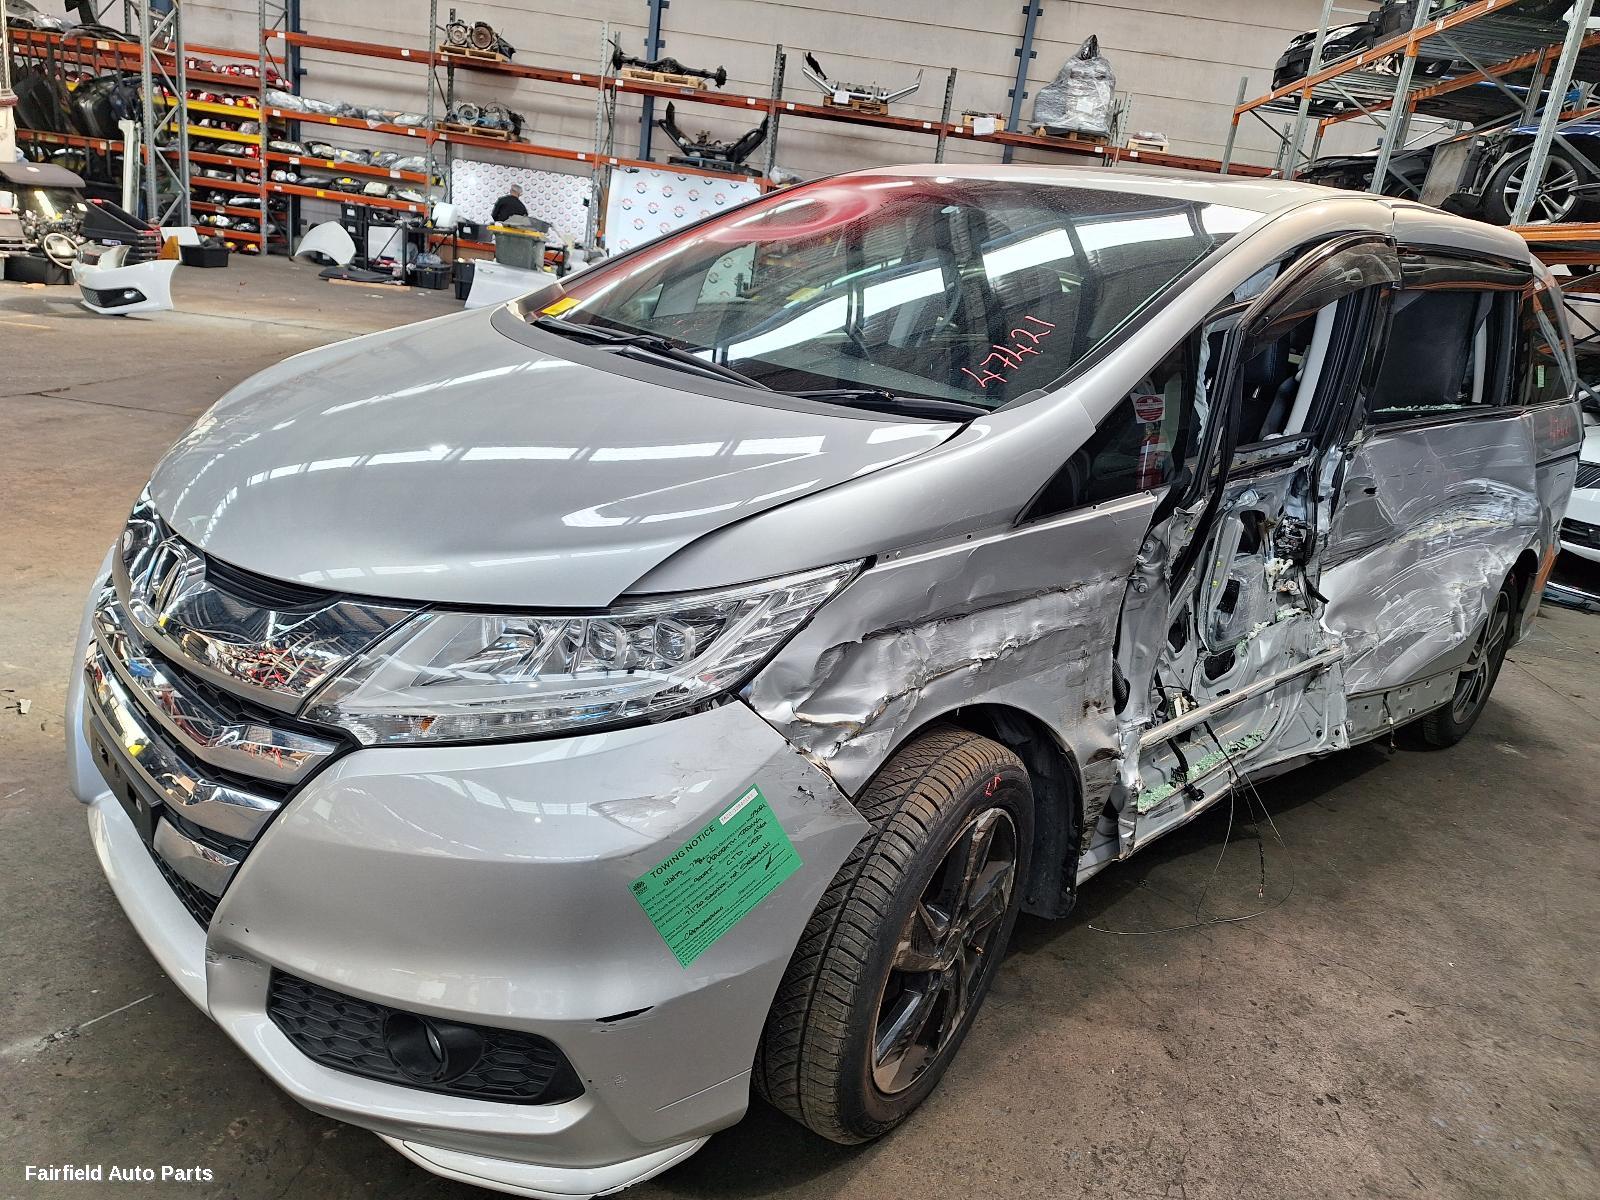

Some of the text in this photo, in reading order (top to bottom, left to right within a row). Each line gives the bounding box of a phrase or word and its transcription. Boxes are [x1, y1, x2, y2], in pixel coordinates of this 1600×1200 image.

[961, 315, 1056, 388] 47421
[650, 850, 686, 878] TOWING
[685, 824, 716, 852] NOTICE
